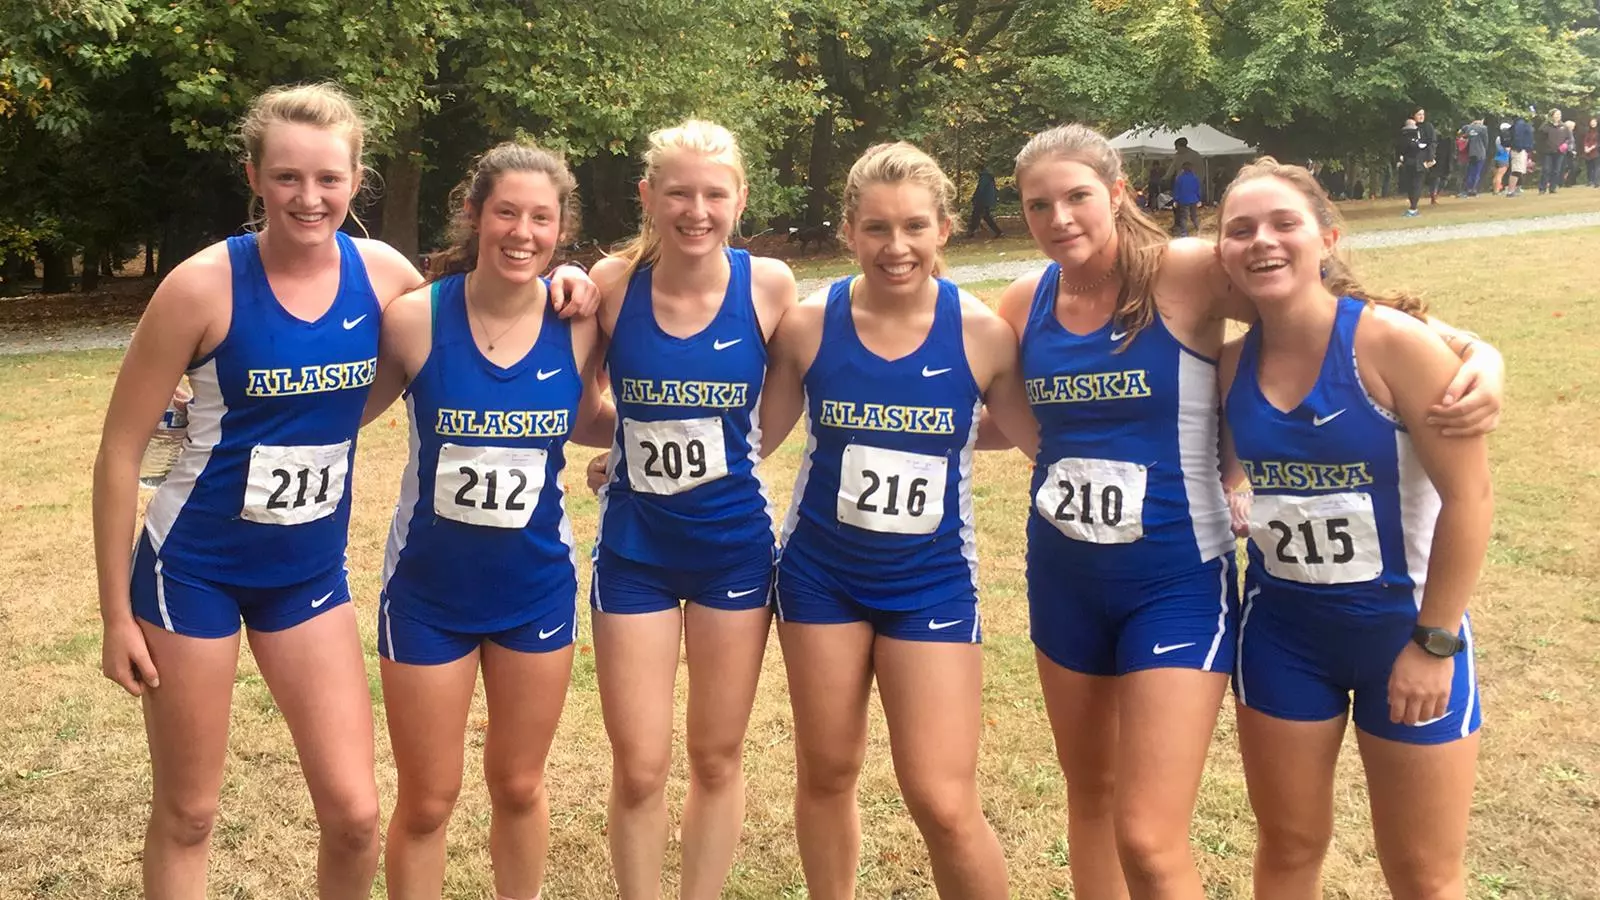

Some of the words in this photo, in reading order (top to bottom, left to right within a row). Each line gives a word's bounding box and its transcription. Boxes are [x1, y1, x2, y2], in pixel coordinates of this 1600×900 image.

[622, 378, 748, 407] ALASKA
[434, 408, 569, 437] ALASKA
[820, 400, 954, 434] ALASKA
[640, 439, 707, 479] 209
[1244, 461, 1373, 489] LASKA
[266, 465, 330, 510] 211
[455, 466, 527, 511] 212
[856, 470, 928, 517] 216
[1055, 480, 1123, 526] 210
[1268, 518, 1356, 564] 215
